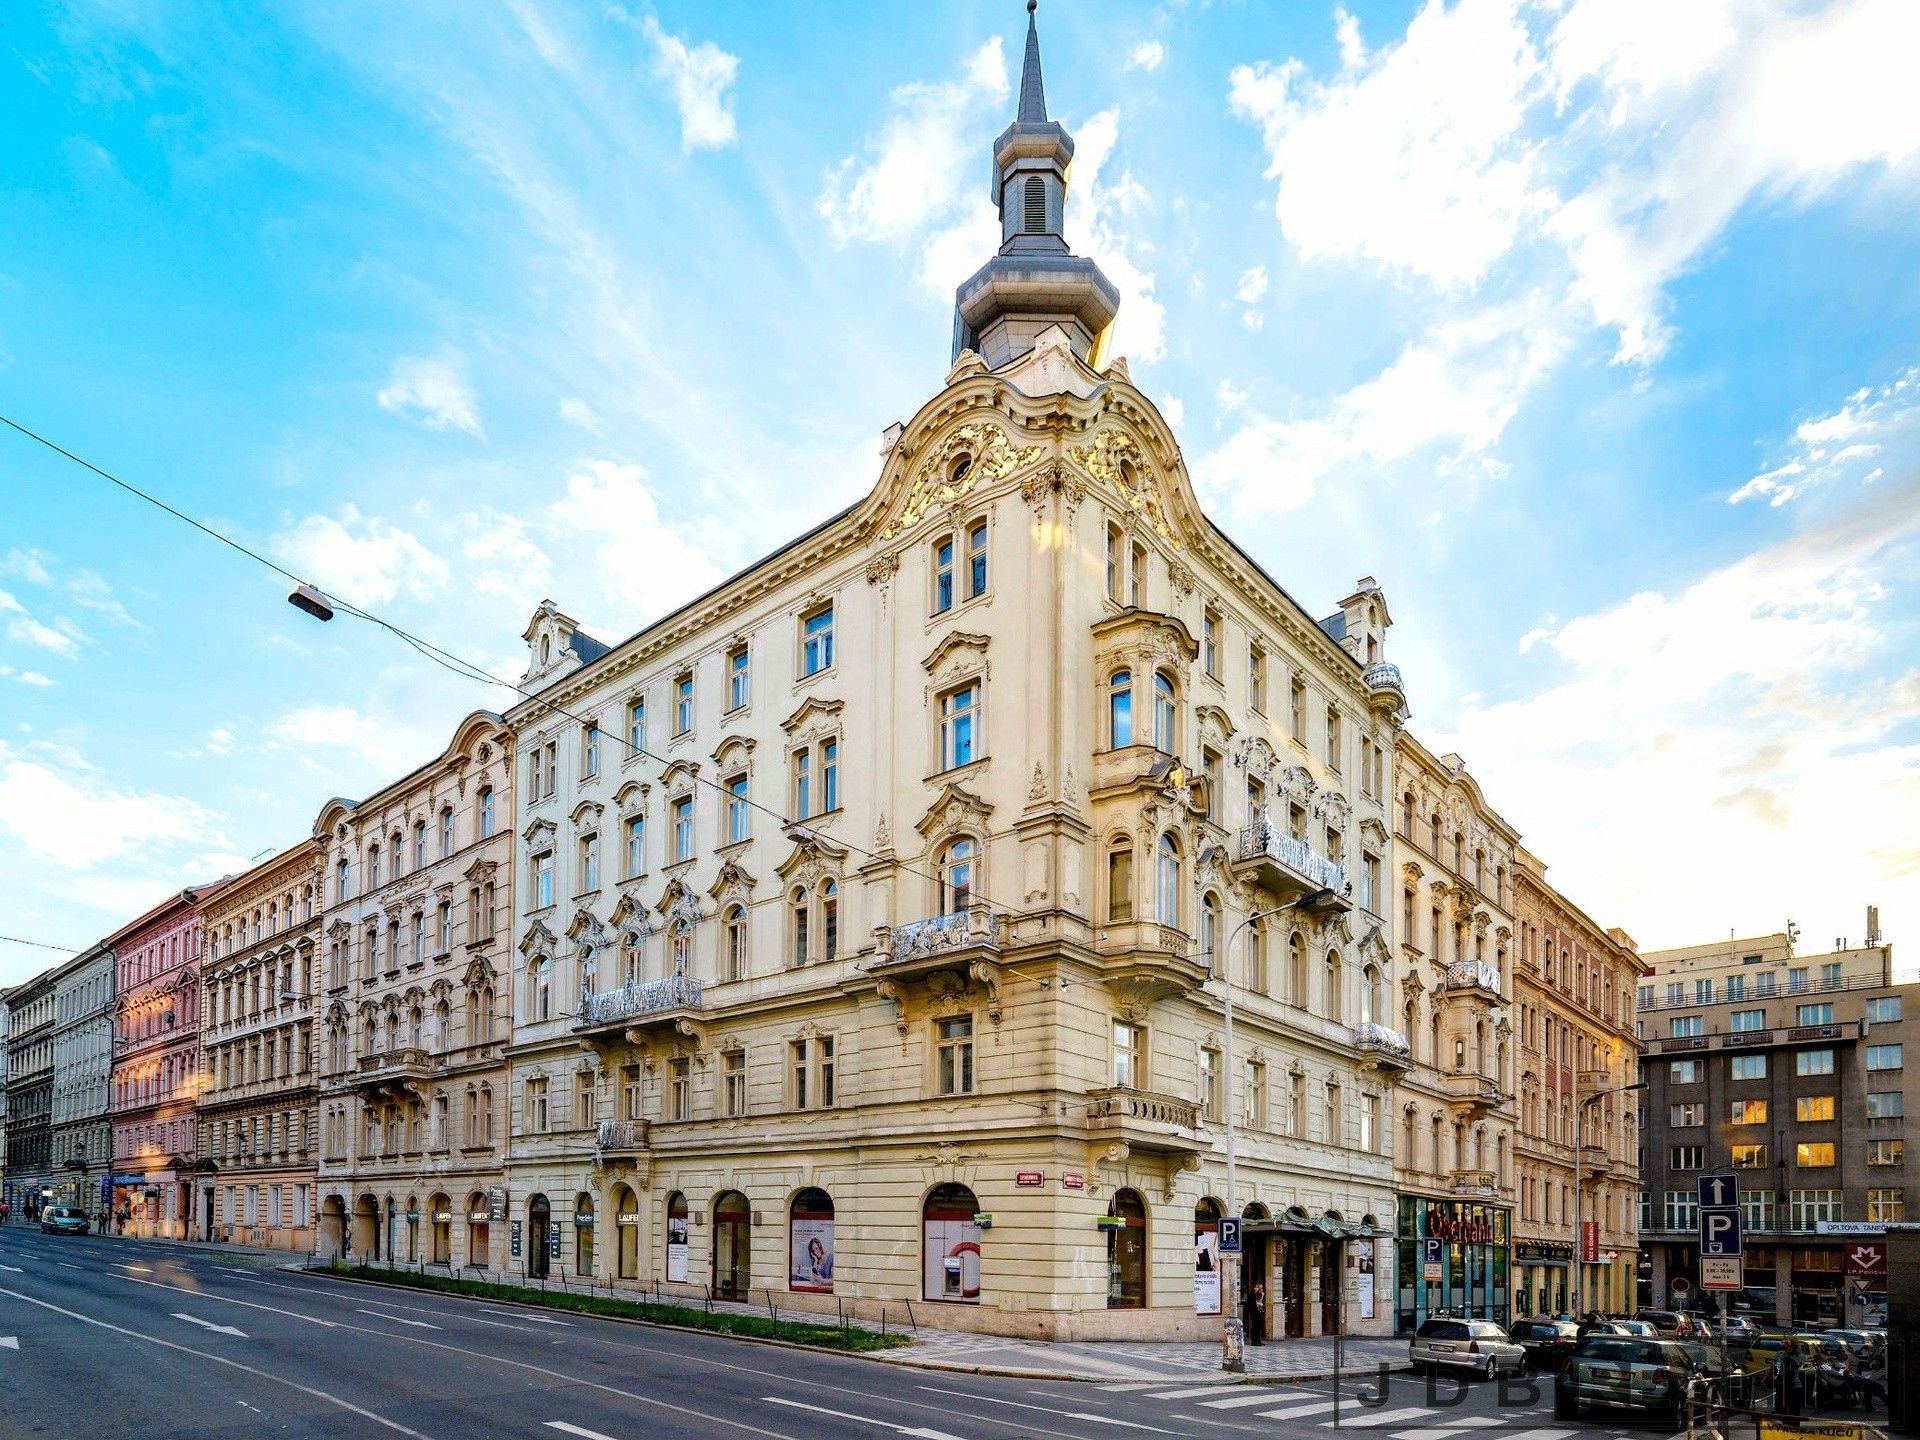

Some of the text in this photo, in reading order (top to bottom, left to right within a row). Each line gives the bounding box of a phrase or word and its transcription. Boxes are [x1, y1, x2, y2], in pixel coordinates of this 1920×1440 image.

[1222, 1222, 1236, 1241] P
[1709, 1215, 1732, 1241] P
[1427, 1240, 1439, 1254] P
